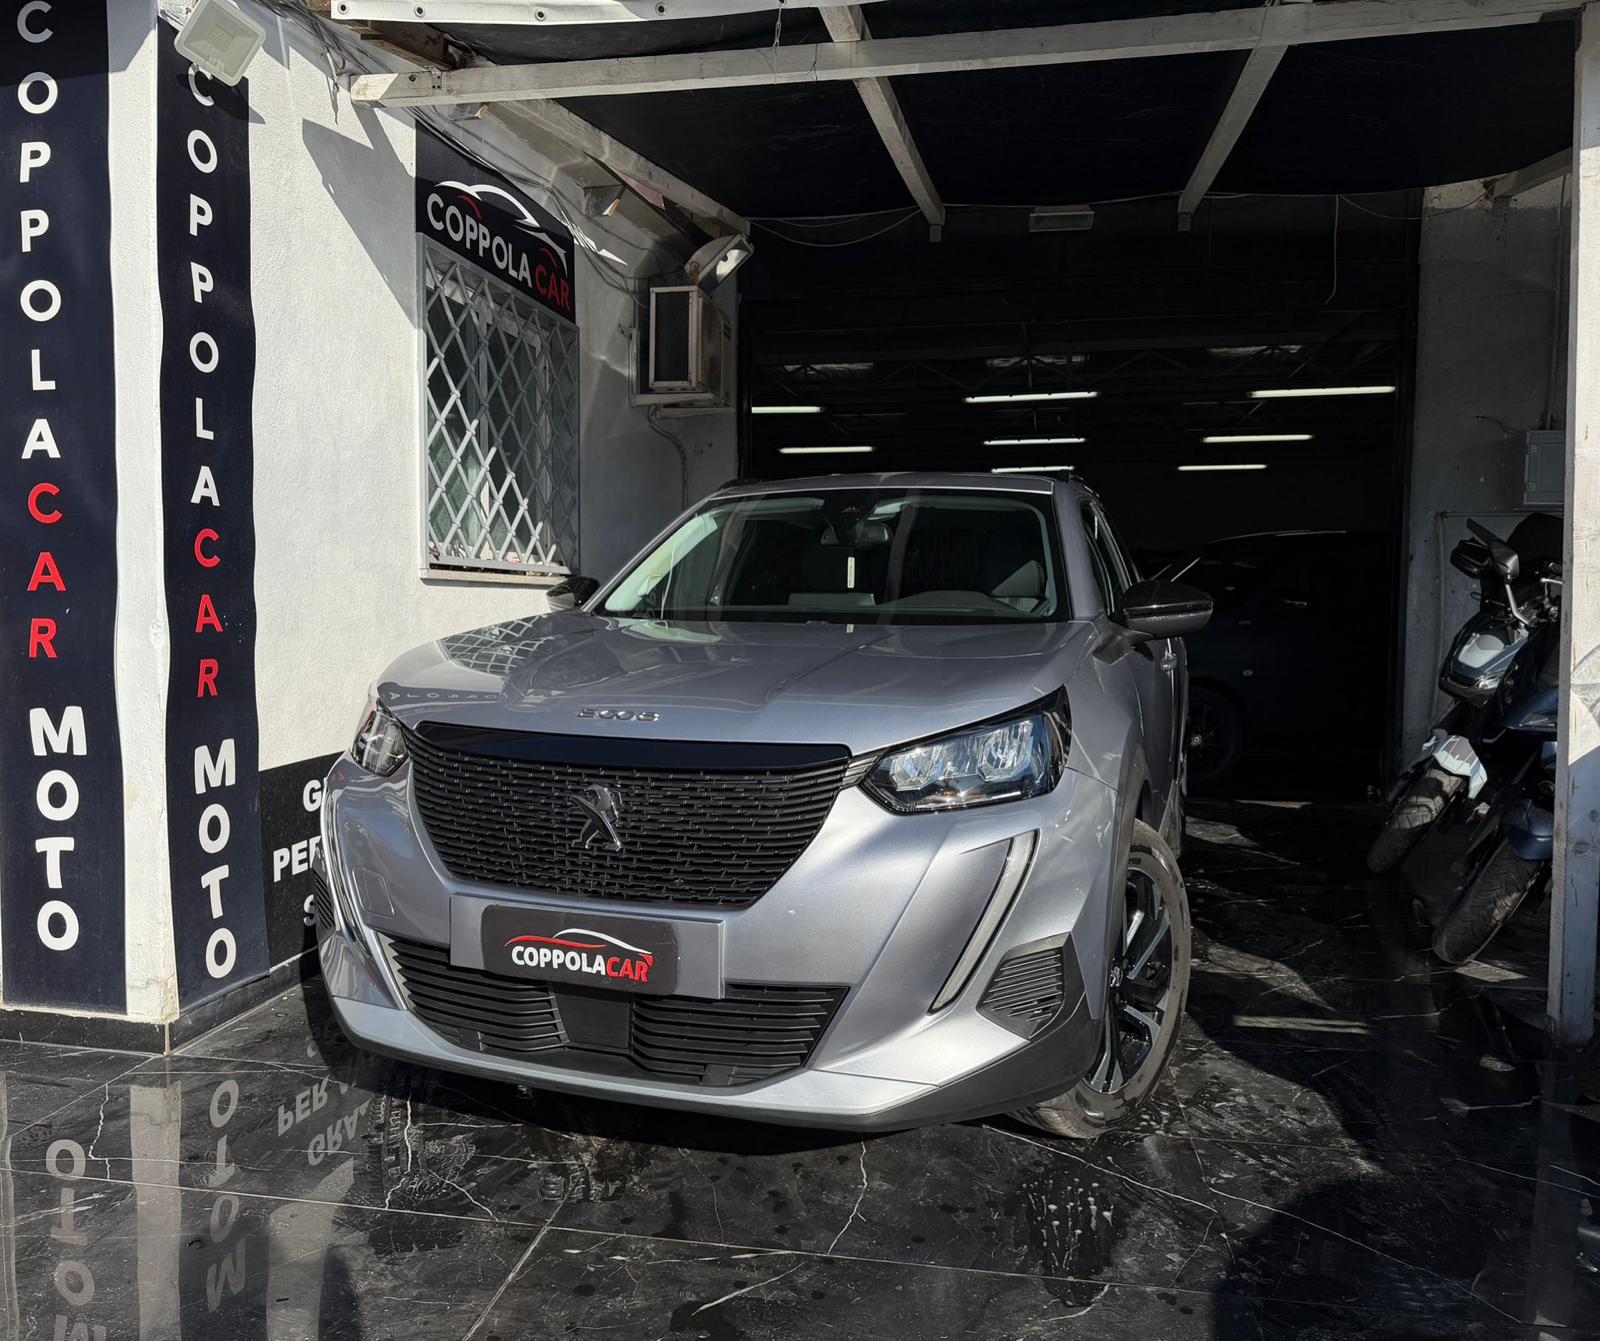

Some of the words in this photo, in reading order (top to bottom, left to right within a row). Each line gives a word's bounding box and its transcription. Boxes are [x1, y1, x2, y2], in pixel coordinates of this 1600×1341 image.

[577, 707, 659, 721] 2008
[29, 706, 88, 952] MOTO
[194, 738, 236, 979] MOTO
[511, 945, 649, 983] COPPOLACAR
